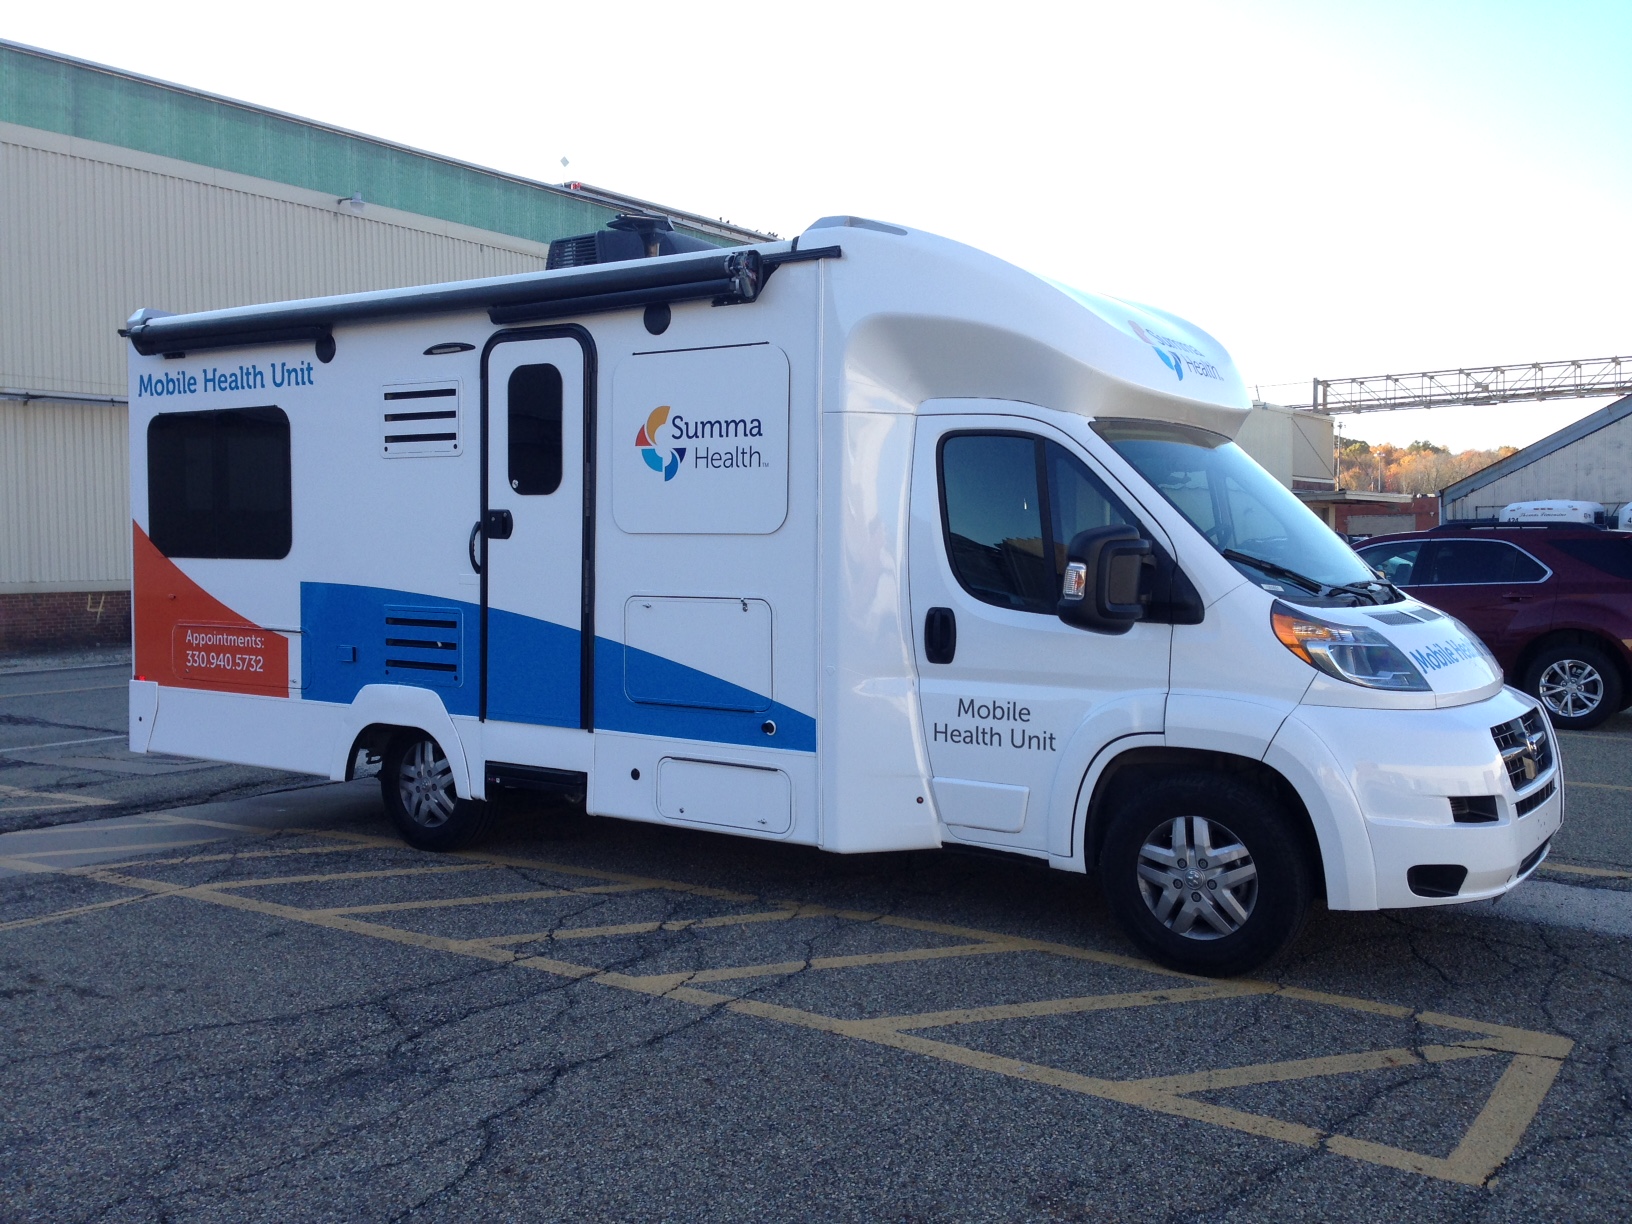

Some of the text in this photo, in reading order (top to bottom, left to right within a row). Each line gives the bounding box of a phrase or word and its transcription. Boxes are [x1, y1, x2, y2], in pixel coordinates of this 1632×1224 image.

[1145, 328, 1205, 357] Summa
[138, 360, 314, 397] Mobile Health Unit
[1180, 354, 1222, 381] Health
[671, 415, 763, 440] Summa
[694, 446, 761, 469] Health
[185, 629, 265, 649] Appointments:
[186, 651, 264, 672] 330.940.5732
[1409, 642, 1460, 674] Mobile
[957, 698, 1031, 723] Mobile
[933, 722, 1057, 752] Health Unit
